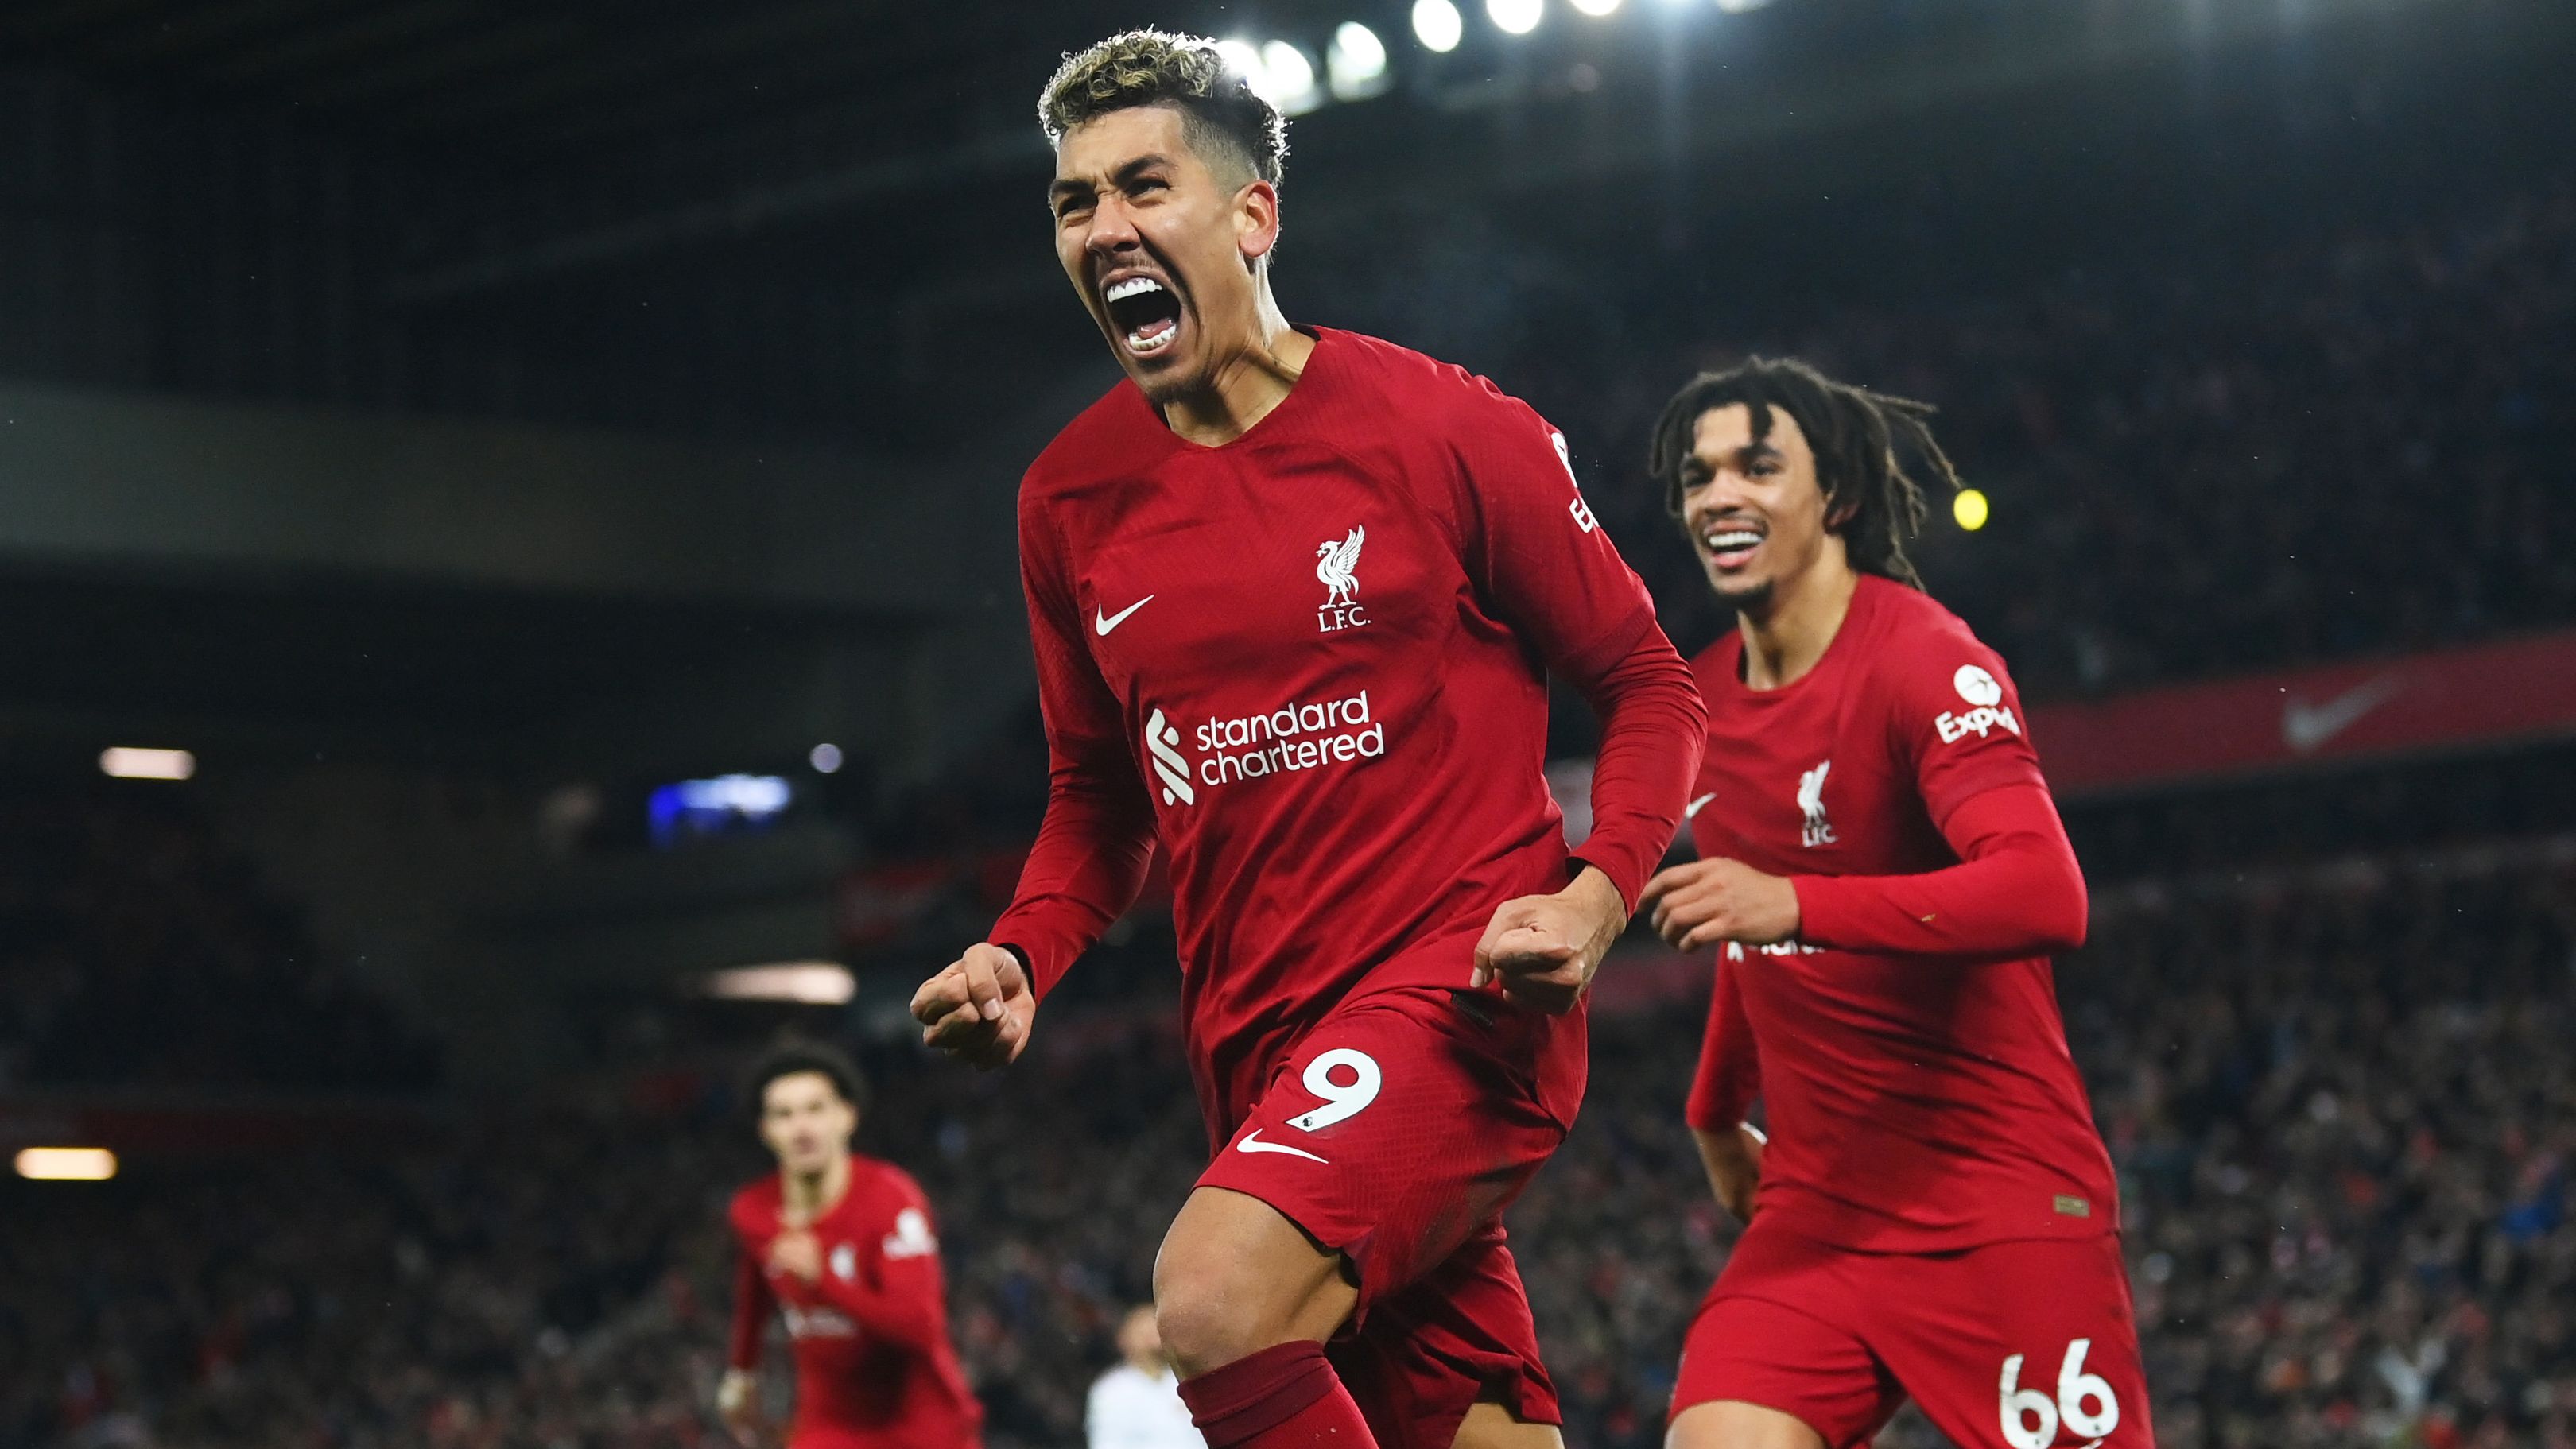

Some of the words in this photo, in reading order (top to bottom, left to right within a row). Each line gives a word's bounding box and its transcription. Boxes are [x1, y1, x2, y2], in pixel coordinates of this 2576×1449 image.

[1317, 606, 1371, 633] L.F.C.
[1196, 689, 1371, 752] standard
[1200, 723, 1385, 786] chartered
[1284, 1048, 1383, 1133] 9
[1998, 1338, 2120, 1449] 66
